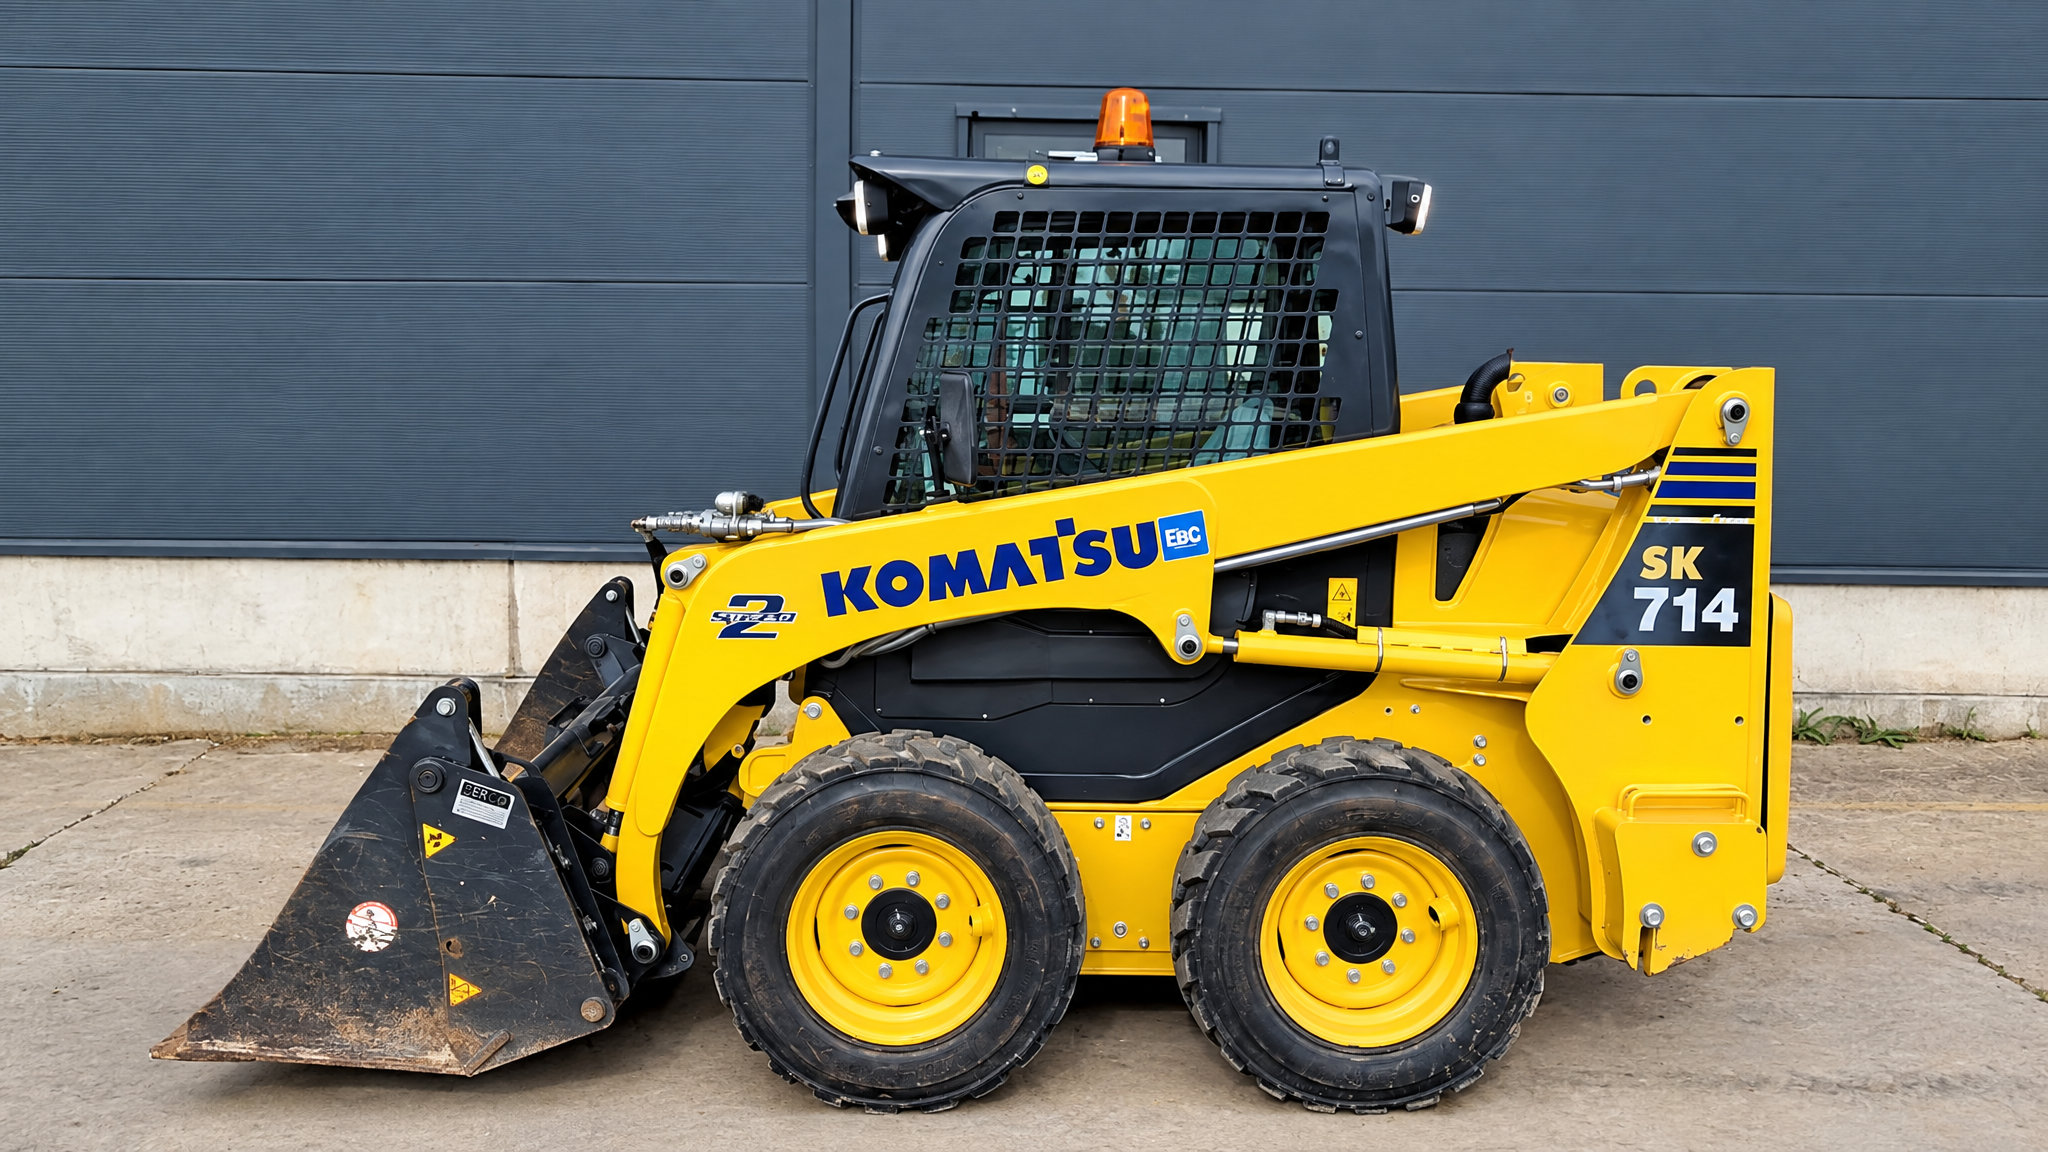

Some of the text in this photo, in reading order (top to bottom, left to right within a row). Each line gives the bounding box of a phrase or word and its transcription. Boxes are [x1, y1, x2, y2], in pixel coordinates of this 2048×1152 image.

[1164, 525, 1202, 548] EBC
[821, 517, 1159, 617] KOMATSU
[1640, 545, 1705, 580] SK
[718, 594, 784, 638] 2
[1633, 587, 1739, 632] 714
